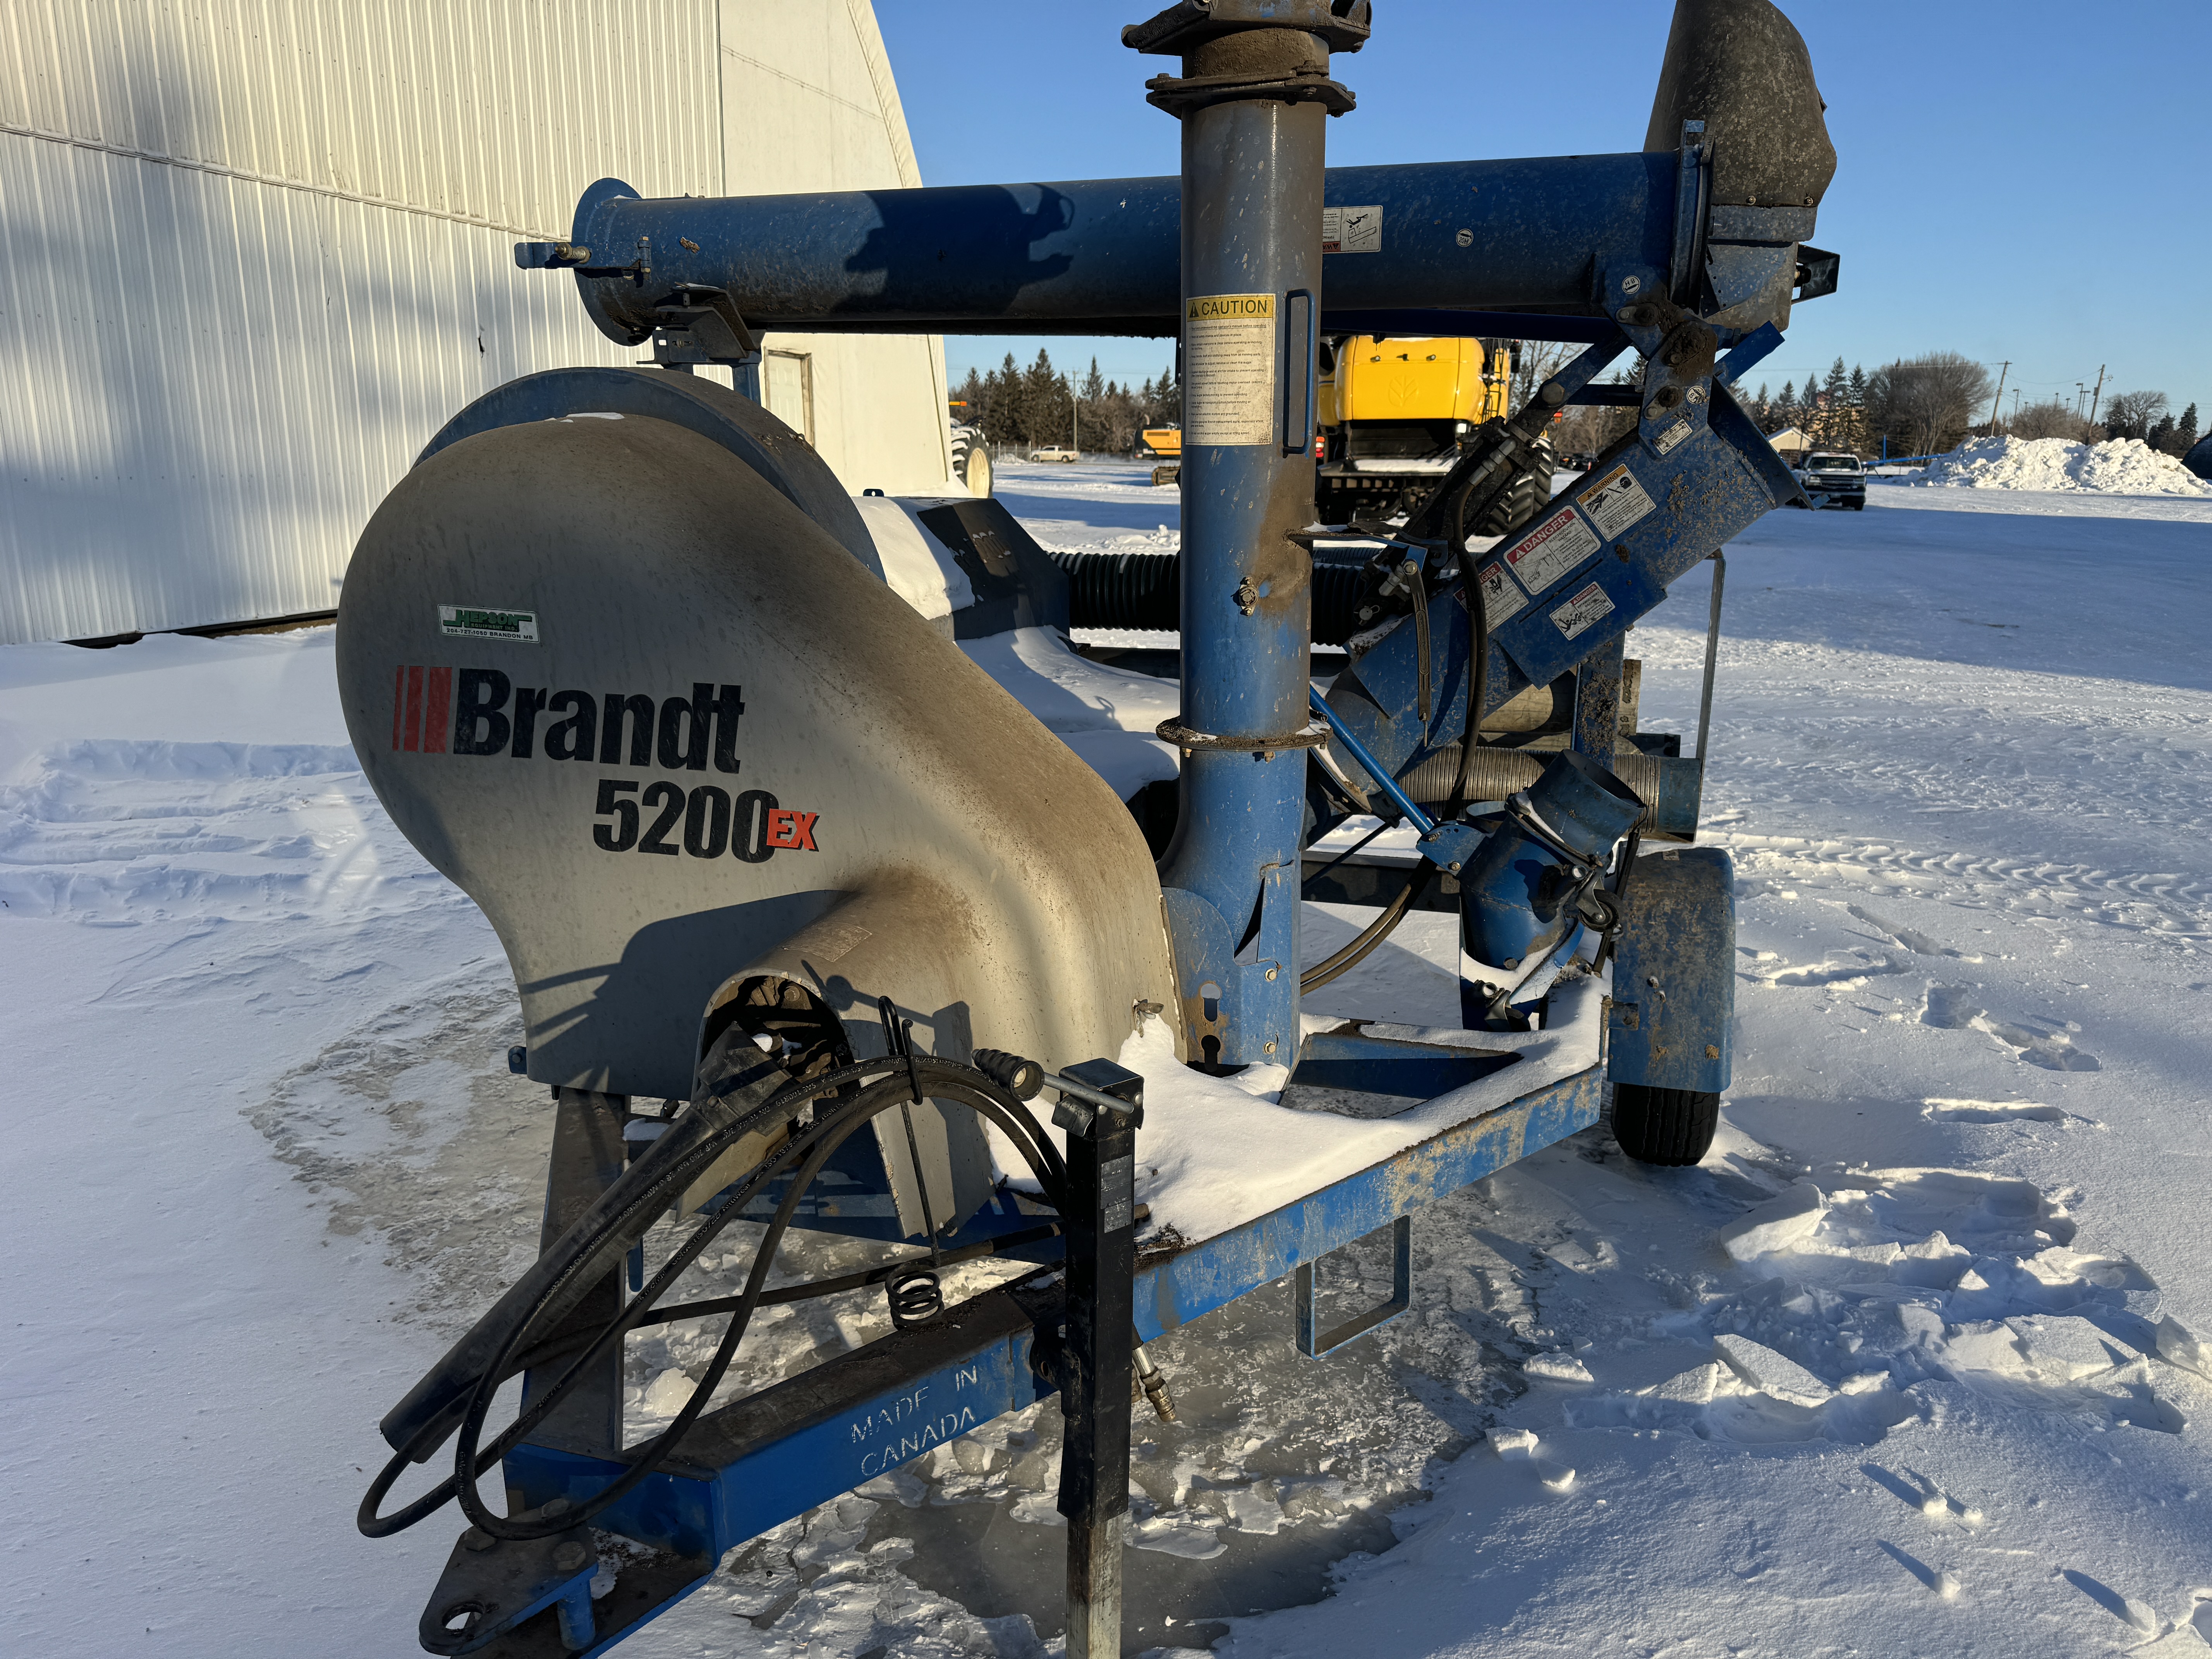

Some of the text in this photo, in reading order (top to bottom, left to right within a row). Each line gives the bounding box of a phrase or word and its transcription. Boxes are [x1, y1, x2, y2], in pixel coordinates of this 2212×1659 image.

[1202, 299, 1267, 315] CAUTION
[1592, 472, 1619, 494] WARNING
[1523, 514, 1568, 551] DANGER
[1548, 522, 1575, 543] ELECTROCUTION
[1558, 530, 1572, 542] HAZARD
[1576, 584, 1597, 602] DANGER
[444, 610, 532, 628] HEPSON
[489, 630, 521, 639] BRANDON
[453, 668, 746, 774] Brandt
[593, 779, 820, 864] 5200 EX
[802, 1082, 817, 1093] SAE
[775, 1089, 801, 1107] 100R19
[758, 1105, 771, 1116] DN
[805, 1118, 820, 1133] SAE
[703, 1139, 718, 1152] WP
[688, 1149, 704, 1163] 280
[675, 1159, 690, 1173] bar
[956, 1365, 977, 1391] IN
[861, 1406, 976, 1476] CANADA
